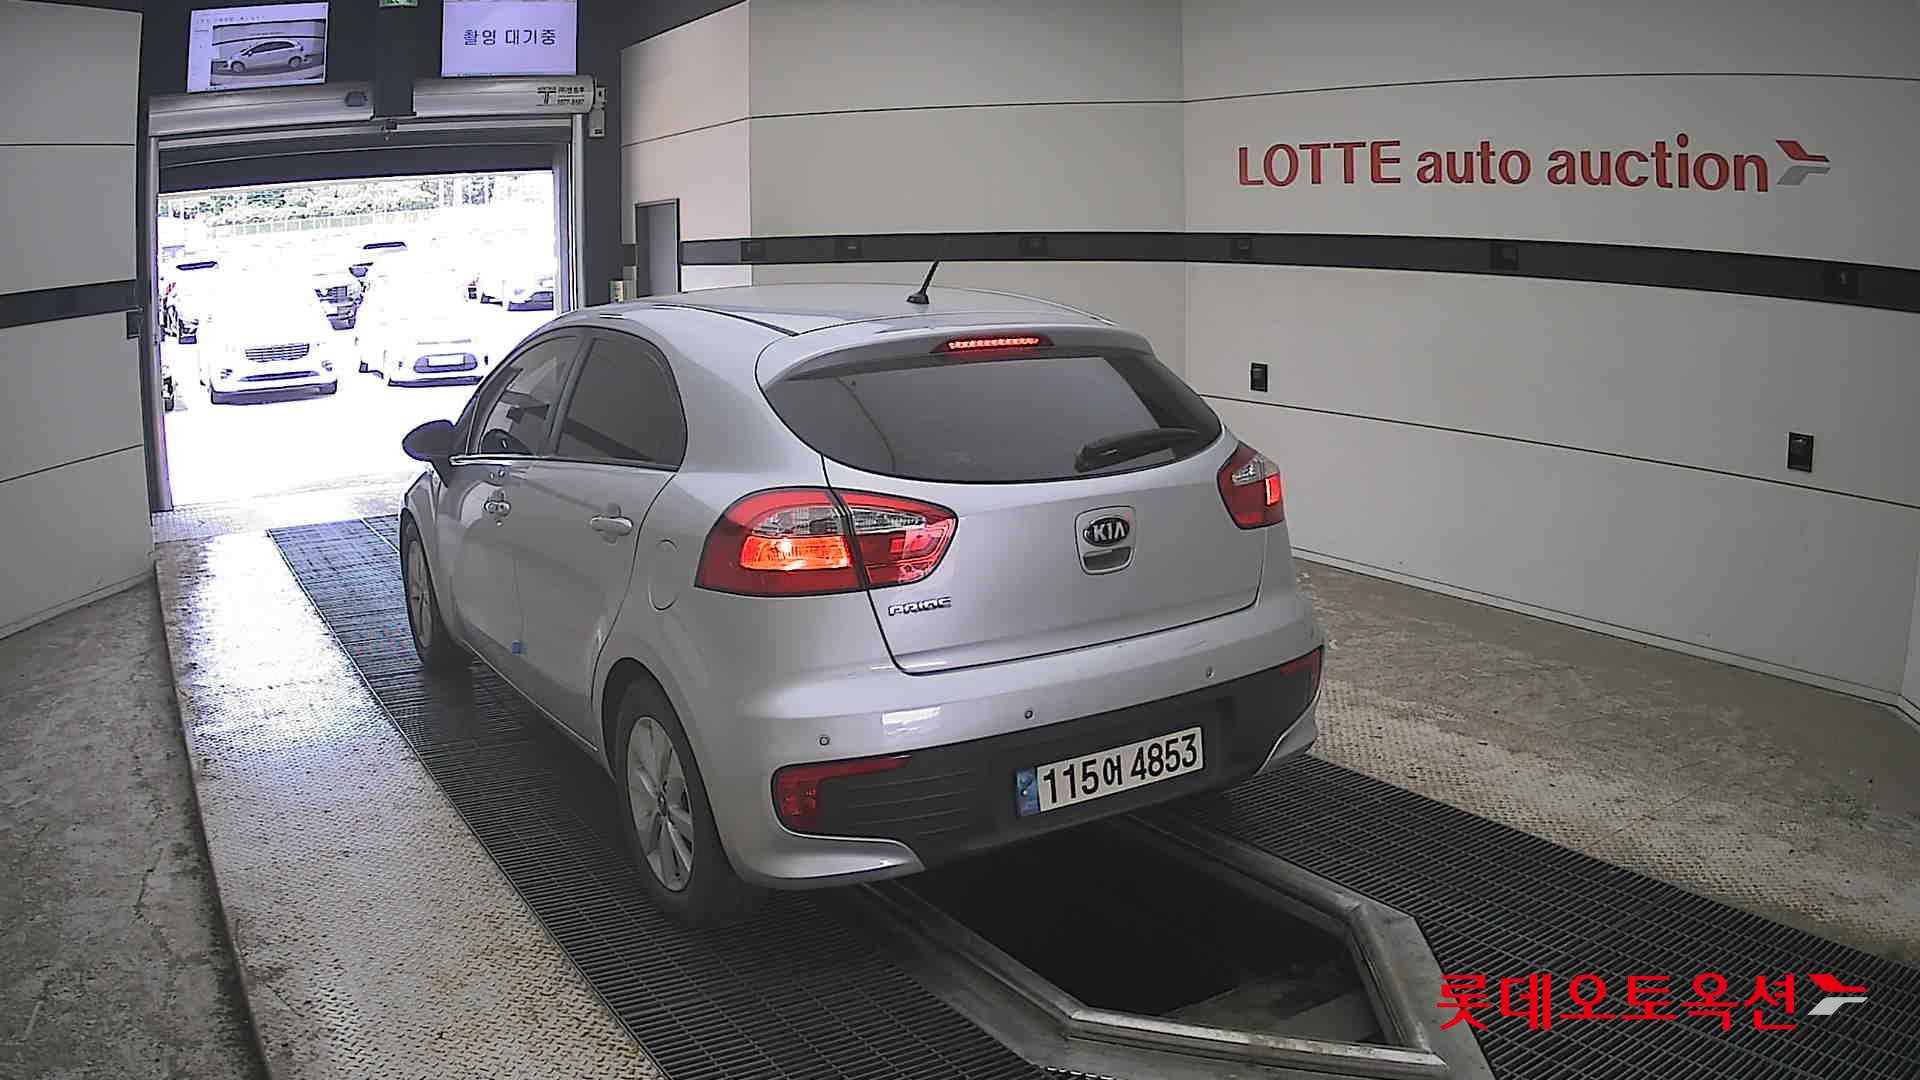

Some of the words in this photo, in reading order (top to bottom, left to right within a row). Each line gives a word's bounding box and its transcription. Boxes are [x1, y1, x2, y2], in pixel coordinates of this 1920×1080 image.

[463, 28, 497, 46] 촬영
[505, 28, 557, 46] 대기중
[1238, 140, 1401, 187] LOTTE
[1416, 140, 1532, 185] auto
[1546, 133, 1769, 193] auction
[1090, 521, 1129, 543] KIA
[1043, 754, 1123, 804] 115어
[1130, 733, 1198, 780] 4853
